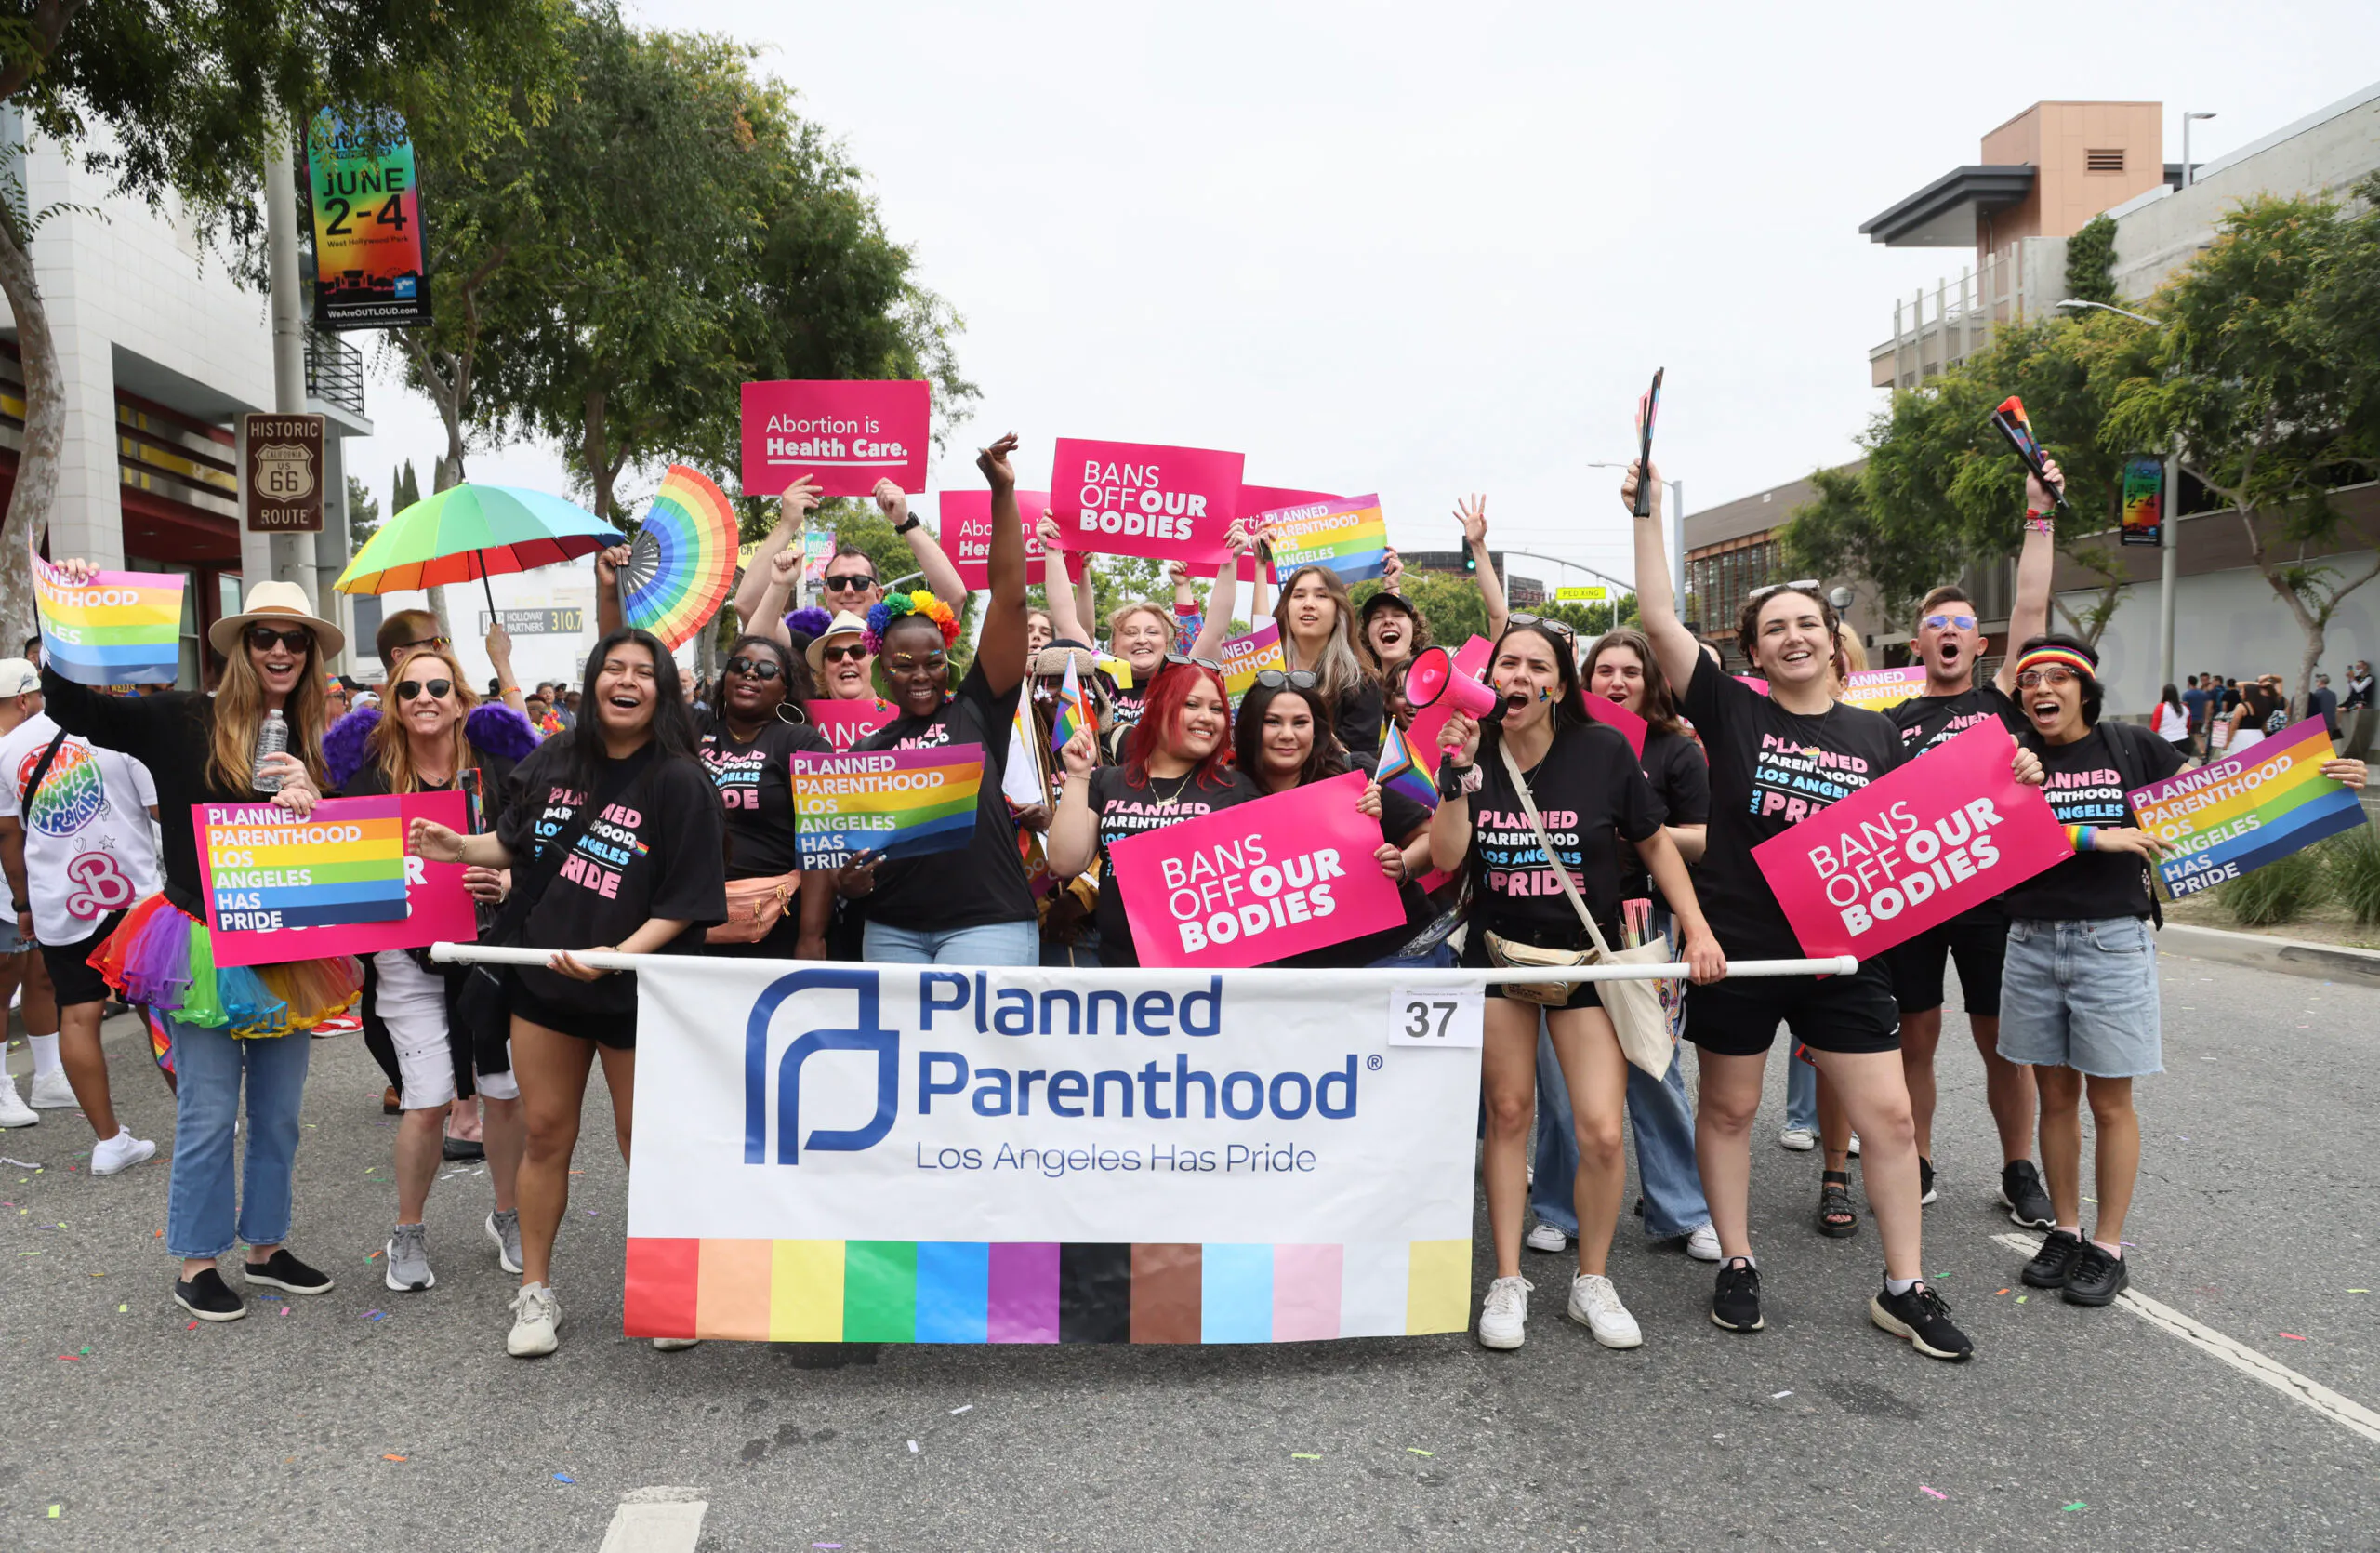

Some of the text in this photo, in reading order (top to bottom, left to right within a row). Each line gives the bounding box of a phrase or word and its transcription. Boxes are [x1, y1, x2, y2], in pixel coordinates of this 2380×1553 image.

[323, 168, 405, 196] JUNE
[324, 194, 407, 235] 2-4
[327, 235, 409, 248] West Hollywood Park
[327, 307, 418, 318] WeAreOUTLOUD.com
[251, 422, 318, 438] HISTORIC
[766, 414, 879, 433] Abortion is
[266, 450, 302, 458] CALIFORNIA
[767, 437, 908, 457] Health Care.
[270, 471, 298, 492] 66
[1084, 459, 1160, 488] BANS
[1079, 484, 1207, 517] OFF OUR
[261, 509, 309, 524] ROUTE
[1079, 509, 1194, 541] BODIES
[1264, 505, 1329, 524] PLANNED
[1272, 538, 1299, 553] LOS
[1276, 547, 1335, 568] ANGELES
[36, 580, 139, 608] ENTHOOD
[507, 611, 544, 622] HOLLOWAY
[507, 622, 544, 632] PARTNERS
[1848, 671, 1906, 687] ANNED
[1762, 733, 1869, 773] PLANED
[794, 756, 896, 775] PLANNED
[795, 772, 944, 795] PARENTHOOD
[1755, 766, 1850, 799] LOS ANGEL
[2039, 768, 2121, 790] ANNED
[2132, 760, 2242, 810] PLANNED
[2045, 788, 2123, 803] ENTHOOD
[2140, 755, 2293, 829] PARENTHOOD
[208, 807, 311, 826] PLANNED
[797, 798, 839, 815] LOS
[1104, 800, 1210, 816] PLANNED
[1749, 790, 1823, 824] HAS PRI
[799, 816, 896, 833] ANGELES
[210, 826, 362, 846] PARENTHOOD
[800, 834, 845, 853] HAS
[1477, 830, 1580, 846] PARENTOOD
[1808, 801, 1918, 880] BANS
[2158, 814, 2261, 865] ANGELES
[213, 850, 254, 869] LOS
[803, 852, 863, 870] PRID
[1161, 834, 1267, 890] BANS
[1479, 848, 1509, 864] LOS
[1826, 797, 2004, 907] OFF OUR
[216, 869, 312, 889] ANGELES
[559, 853, 622, 900] RIDE
[2163, 854, 2213, 883] HAS
[1169, 848, 1347, 921] OFF OUR
[1840, 835, 2000, 937] BODIES
[2171, 861, 2241, 898] PRIDE
[218, 892, 261, 910] HAS
[220, 911, 283, 931] PRIDE
[1178, 883, 1337, 954] BODIES
[919, 970, 1223, 1037] Planned
[1405, 1002, 1458, 1038] 37
[918, 1051, 1358, 1120] Parenthood
[917, 1141, 1316, 1177] Los Angeles Has Pride
